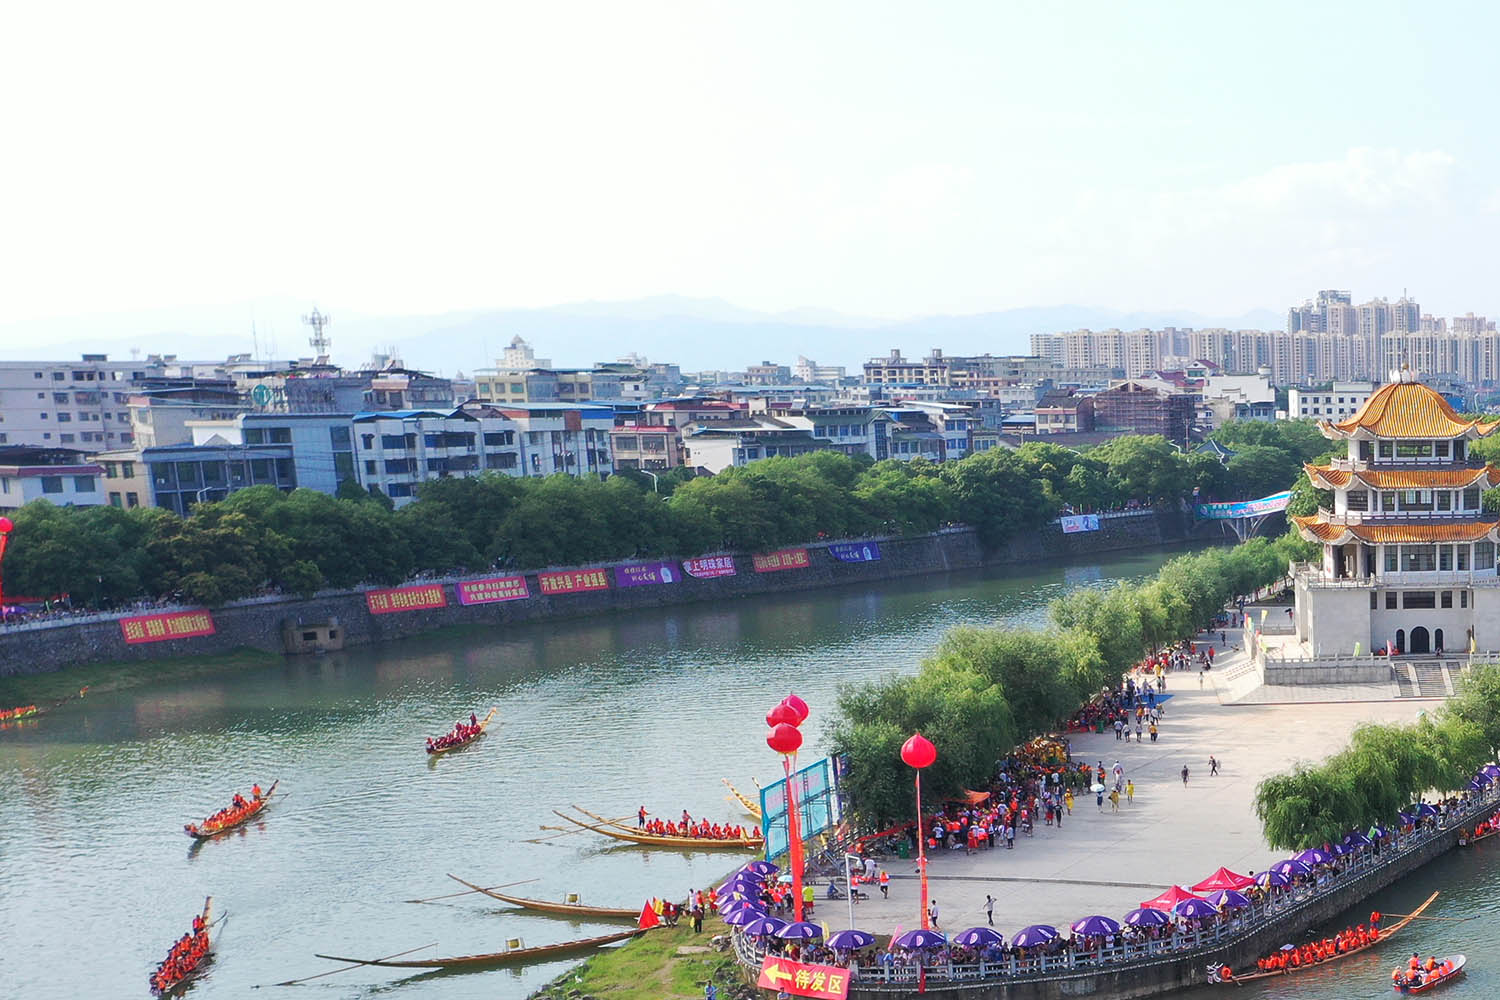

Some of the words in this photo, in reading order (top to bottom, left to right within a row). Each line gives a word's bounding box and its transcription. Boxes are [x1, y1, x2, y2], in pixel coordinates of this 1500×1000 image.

[541, 575, 573, 591] 开放兴县
[575, 572, 606, 587] 产业强县
[795, 969, 843, 994] 待发区
